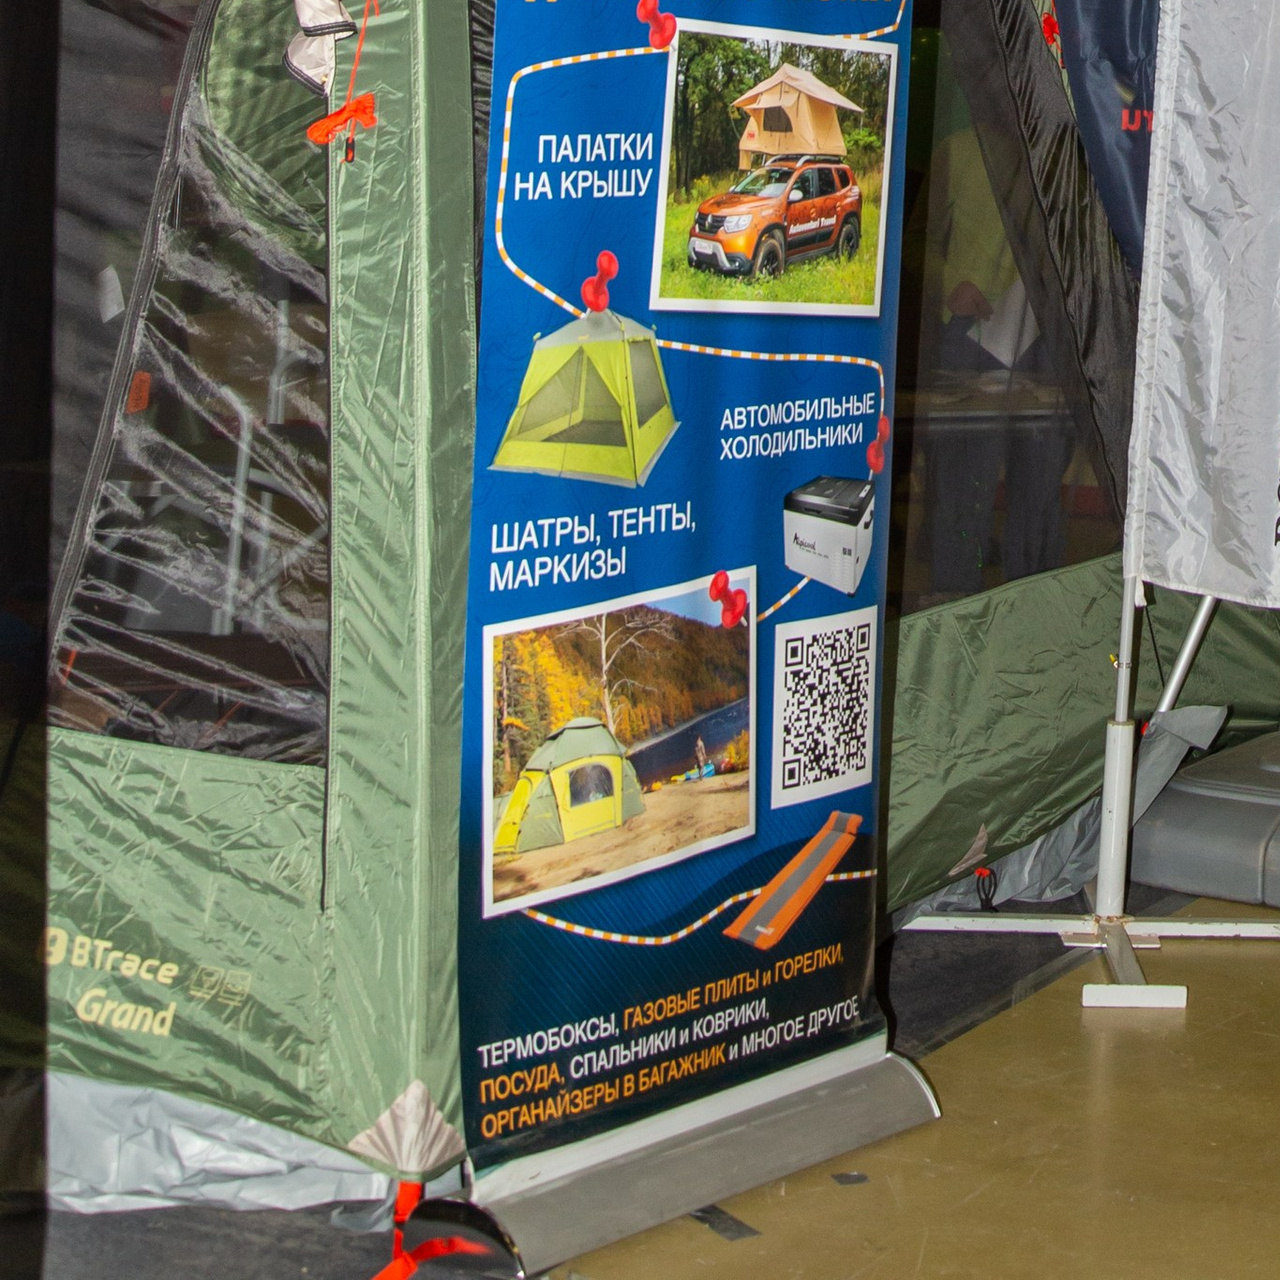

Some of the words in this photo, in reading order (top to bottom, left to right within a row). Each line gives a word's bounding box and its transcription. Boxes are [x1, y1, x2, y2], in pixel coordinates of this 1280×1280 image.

[538, 132, 653, 163] ПАЛАТКИ
[514, 171, 553, 201] НА
[560, 168, 653, 199] КРЫШУ
[720, 392, 876, 431] АВТОМОБИЛЬНЫЕ
[720, 422, 863, 461] ХОЛОДИЛЬНИКИ
[491, 513, 601, 554] ШАТРЫ,
[608, 500, 696, 539] ТЕНТЫ,
[489, 546, 627, 592] МАРКИЗЫ
[71, 935, 180, 985] BTrace
[76, 988, 177, 1037] Grand
[477, 1014, 621, 1069] ТЕРМОБОКСЫ,
[622, 987, 701, 1032] ГАЗОВЫЕ
[704, 969, 759, 1006] ПЛИТЫ
[762, 971, 772, 987] и
[774, 942, 845, 982] ГОРЕЛКИ,
[479, 1067, 565, 1105] ПОСУДА,
[569, 1027, 676, 1081] СПАЛЬНИКИ
[679, 1028, 689, 1045] и
[692, 997, 771, 1040] КОВРИКИ,
[480, 1076, 620, 1139] ОРГАНАЙЗЕРЫ
[623, 1073, 636, 1097] В
[638, 1043, 727, 1093] БАГАЖНИК
[728, 1043, 739, 1061] и
[741, 1014, 805, 1056] МНОГОЕ
[807, 994, 860, 1038] ДРУГОЕ
